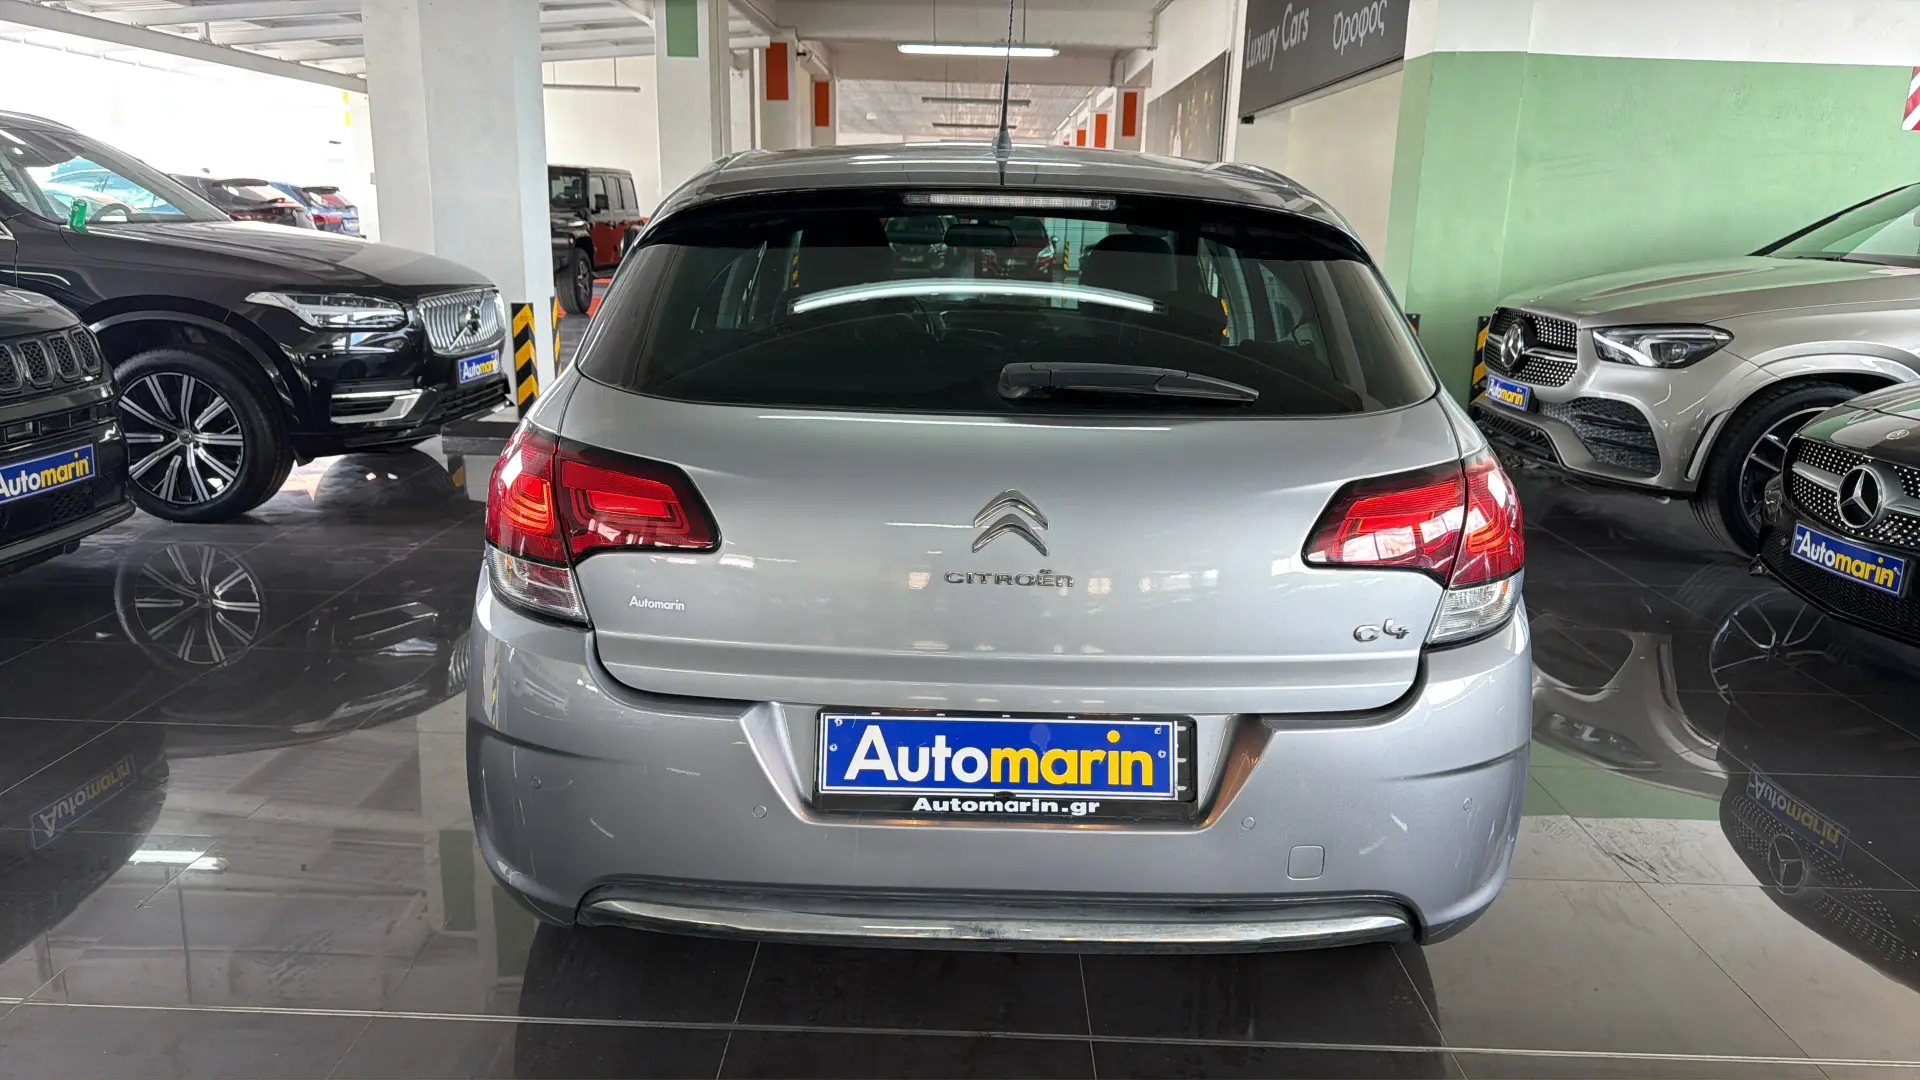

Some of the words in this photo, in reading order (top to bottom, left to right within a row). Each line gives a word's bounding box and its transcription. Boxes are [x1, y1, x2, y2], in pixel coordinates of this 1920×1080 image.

[1246, 25, 1280, 71] Luxury
[1282, 3, 1309, 51] Cars
[1797, 531, 1894, 588] Automarin
[629, 596, 685, 611] Automarin
[1353, 618, 1410, 642] C4
[844, 725, 1153, 785] Automarin
[912, 797, 1100, 816] Automarin.gr
